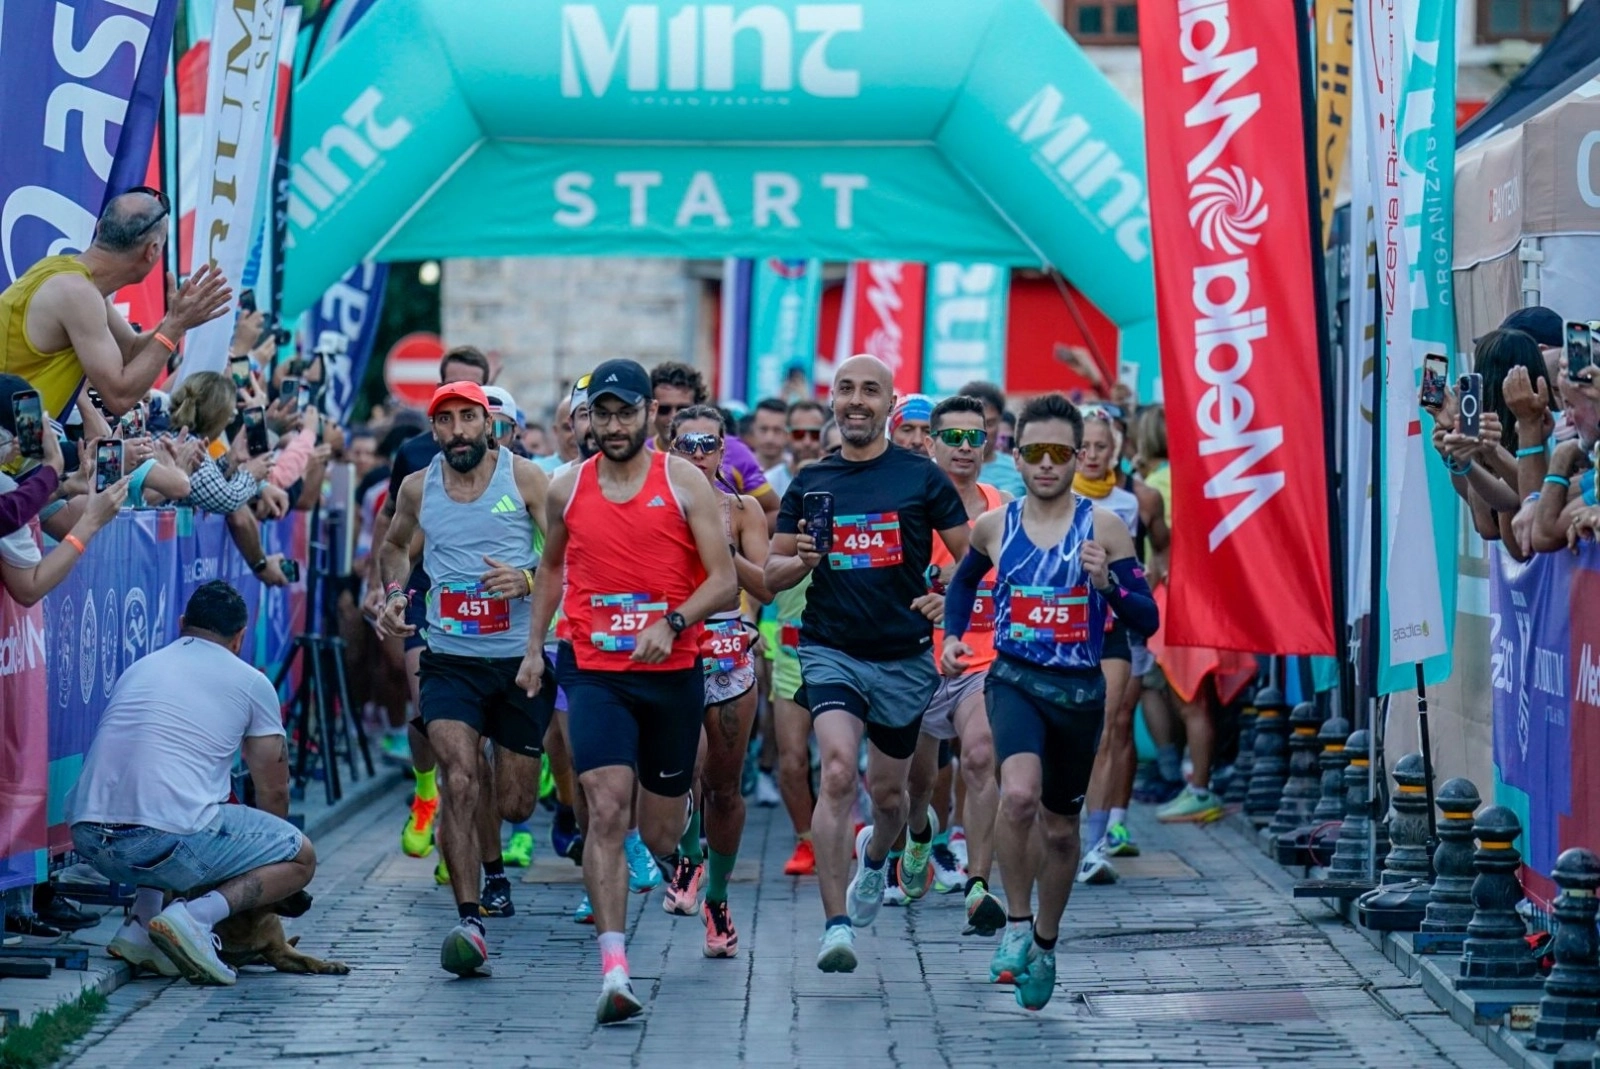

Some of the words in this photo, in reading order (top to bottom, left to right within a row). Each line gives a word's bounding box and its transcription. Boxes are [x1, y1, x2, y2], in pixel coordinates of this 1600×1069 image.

[553, 171, 869, 229] START
[844, 531, 884, 550] 494
[457, 600, 490, 617] 451
[1028, 606, 1070, 624] 475
[610, 613, 649, 631] 257
[711, 636, 742, 655] 236
